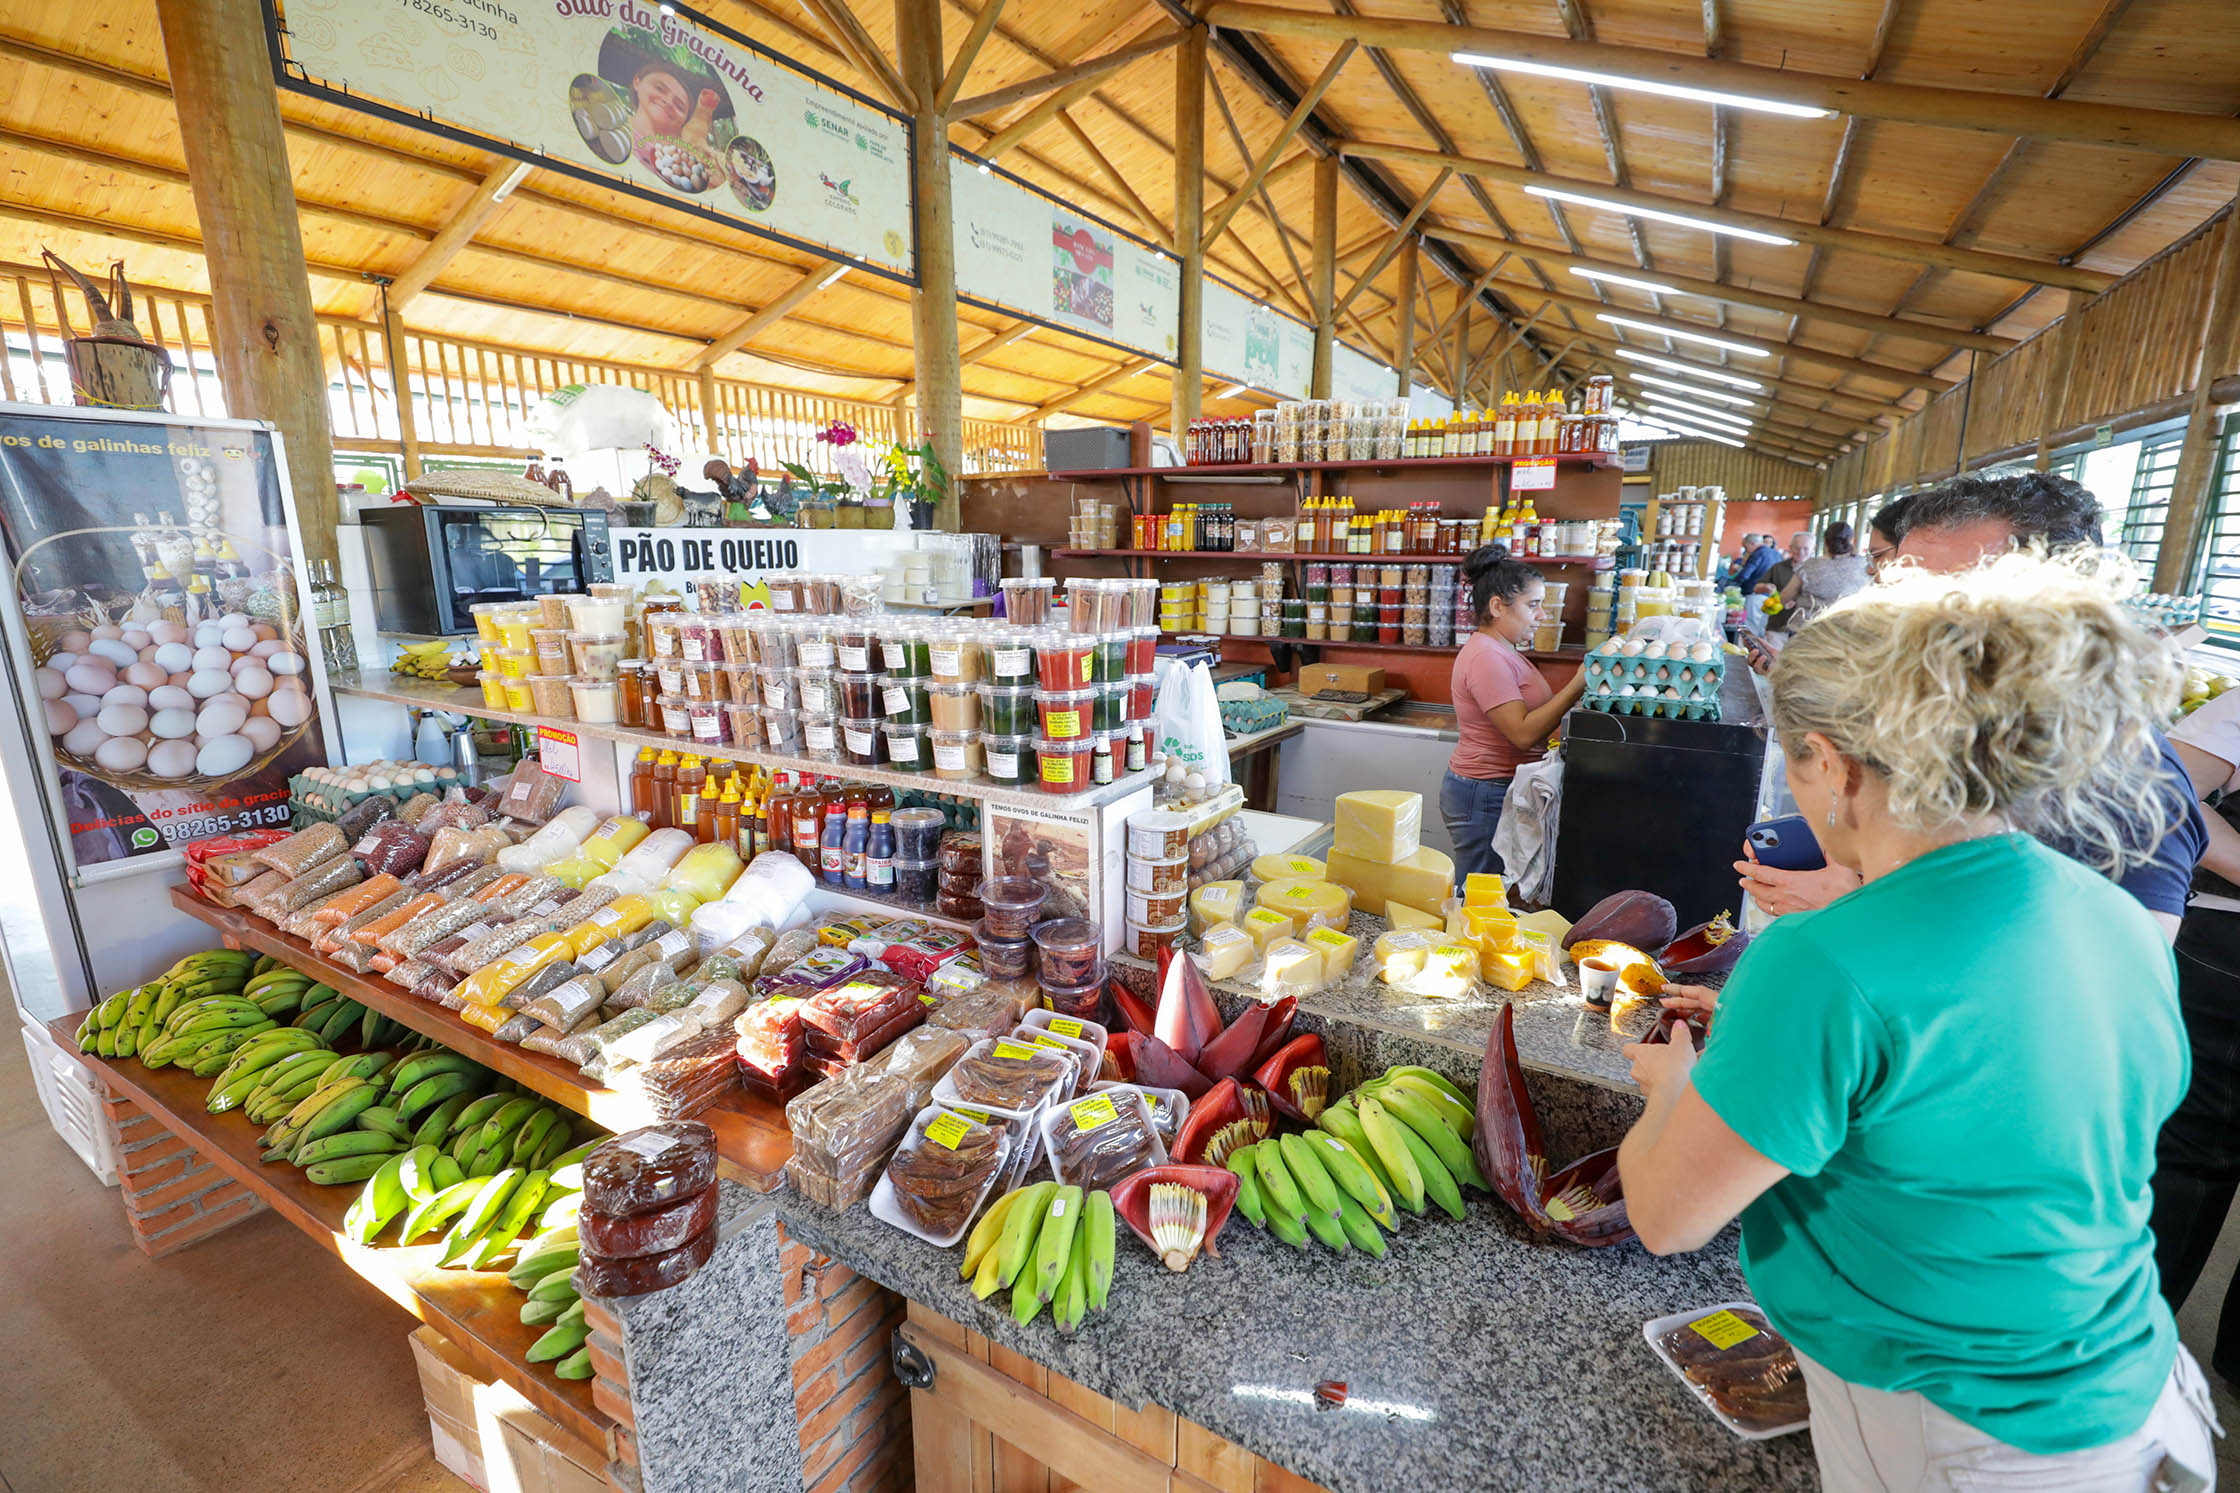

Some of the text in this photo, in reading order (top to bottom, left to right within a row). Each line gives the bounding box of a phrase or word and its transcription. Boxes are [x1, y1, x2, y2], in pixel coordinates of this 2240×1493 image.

[619, 0, 655, 31] da
[660, 14, 765, 103] Gracinha
[821, 118, 849, 137] SENAR
[37, 434, 66, 449] de
[72, 438, 163, 456] galinhas
[167, 442, 211, 457] feliz
[619, 532, 799, 573] PÃO DE QUEIJO
[539, 727, 576, 744] PROMOÇÃO
[1183, 752, 1204, 762] SDS
[70, 813, 146, 834] Delicias
[151, 807, 173, 820] do
[177, 797, 216, 815] sítio
[218, 794, 241, 810] da
[161, 803, 291, 843] 98265-3130
[991, 804, 1011, 812] TEMOS
[1012, 807, 1029, 816] OVOS
[1039, 812, 1068, 821] GALINHA
